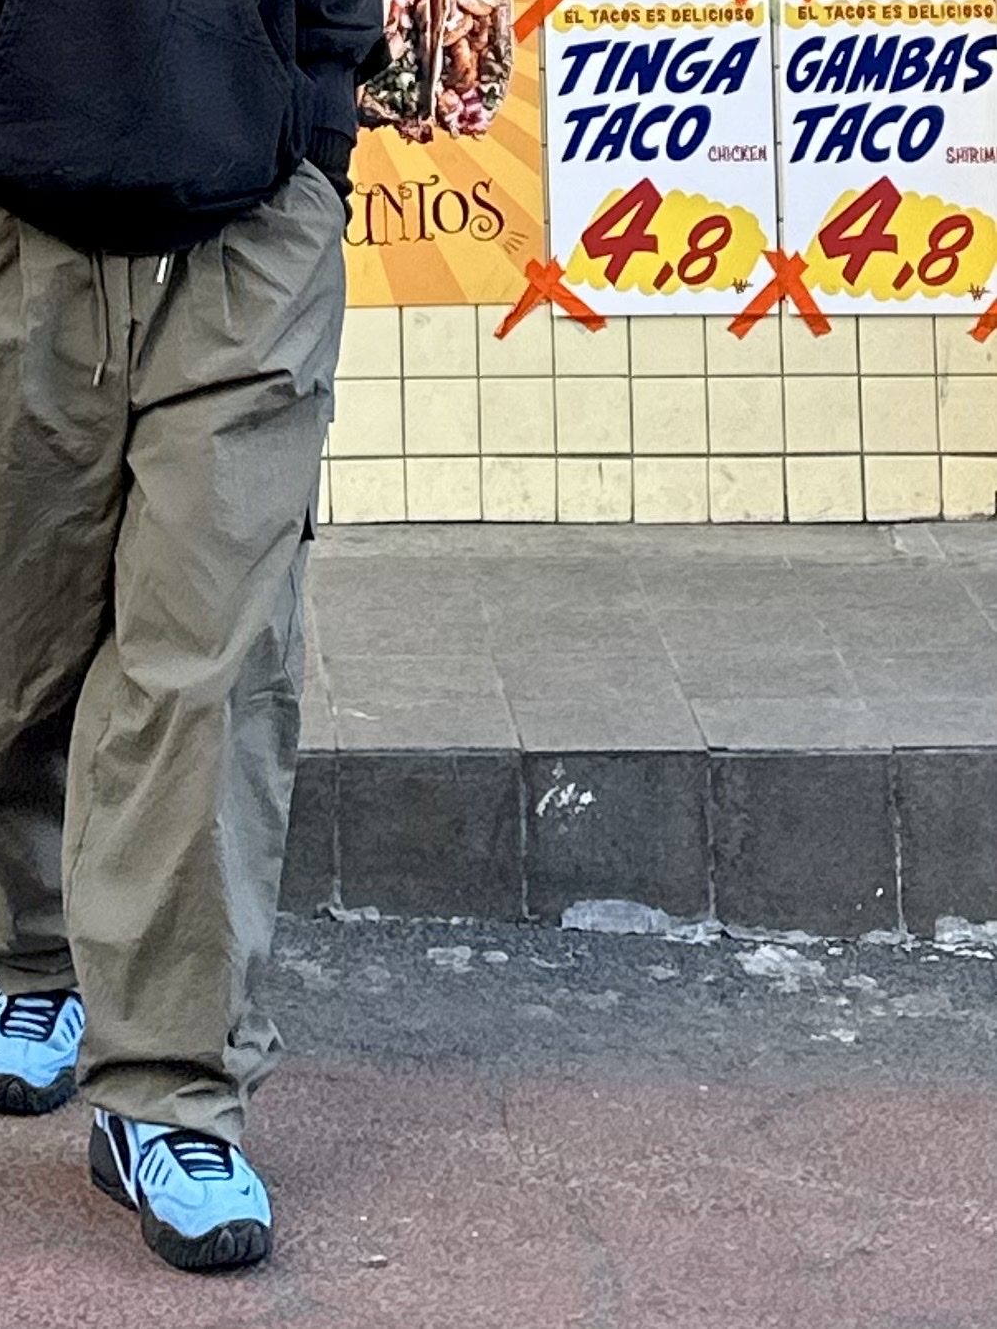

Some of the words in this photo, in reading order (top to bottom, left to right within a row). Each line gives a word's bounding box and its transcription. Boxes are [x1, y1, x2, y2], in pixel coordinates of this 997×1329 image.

[564, 9, 584, 24] EL
[589, 9, 641, 24] TACOS
[646, 9, 666, 22] ES
[671, 7, 755, 22] DELICIOSO
[797, 5, 818, 20] EL
[824, 5, 876, 20] TACOS
[882, 4, 902, 19] ES
[908, 4, 994, 19] DELICIOSO
[558, 36, 761, 96] TINGA
[786, 34, 997, 95] GAMBAS
[561, 102, 712, 163] TACO
[707, 145, 768, 163] CHICKEN
[789, 102, 946, 164] TACO
[344, 174, 505, 247] UNTOS
[581, 177, 733, 290] 4,8
[817, 175, 975, 291] 4,8
